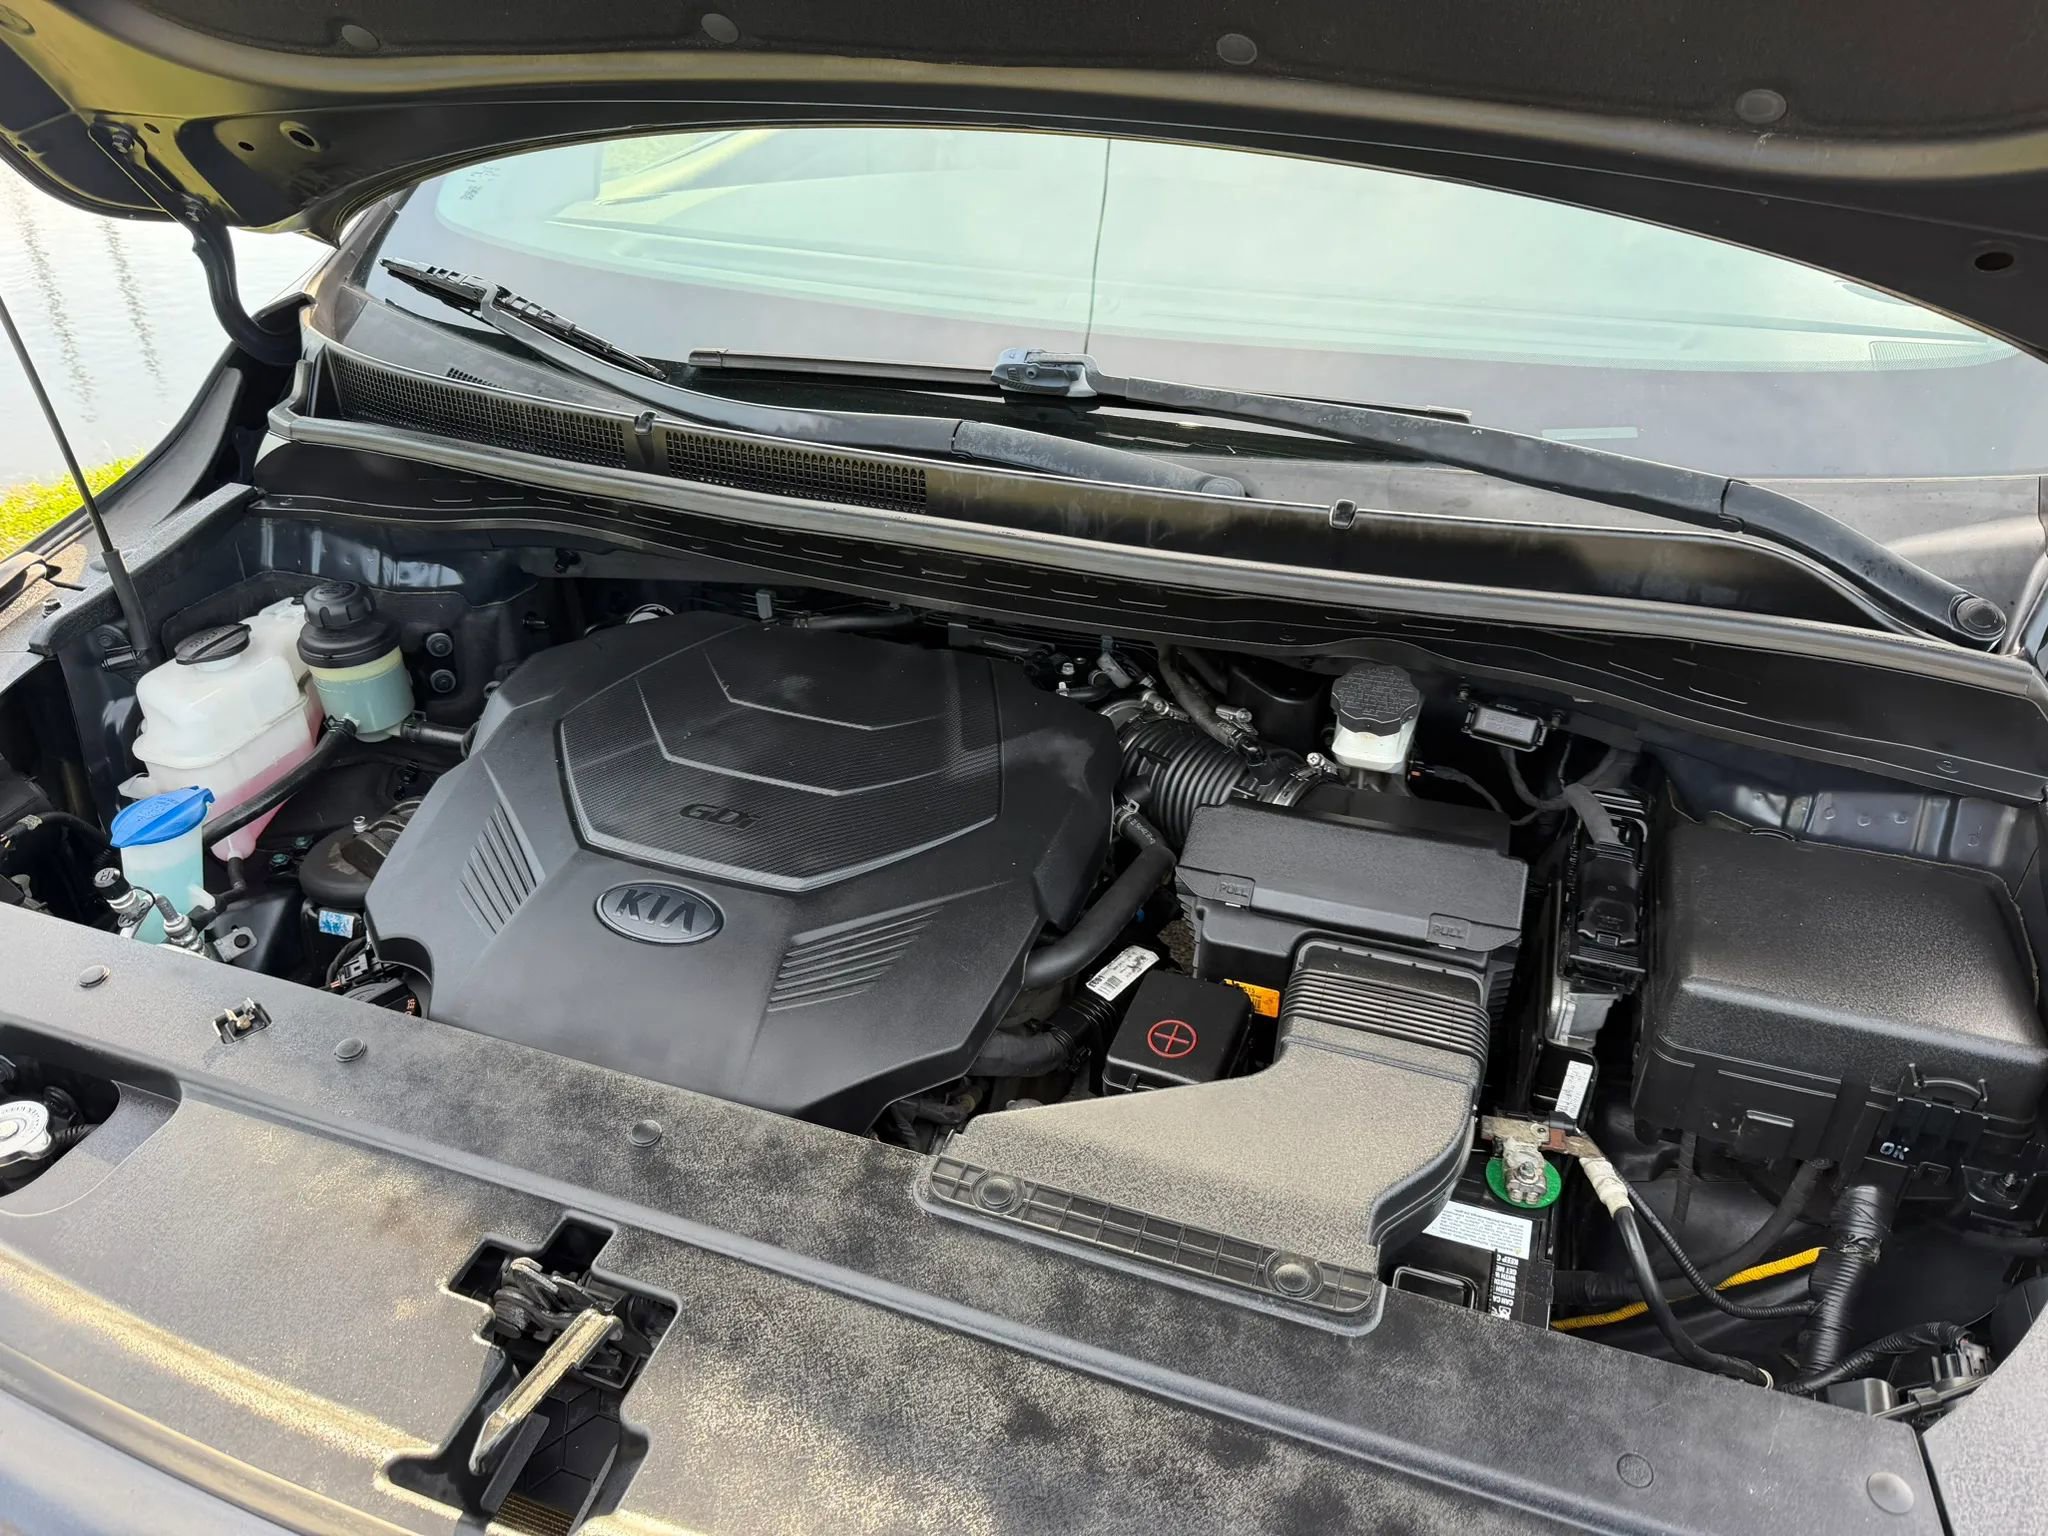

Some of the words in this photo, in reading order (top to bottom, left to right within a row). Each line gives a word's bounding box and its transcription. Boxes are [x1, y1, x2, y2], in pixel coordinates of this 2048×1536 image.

[1219, 881, 1249, 898] PULL
[613, 888, 697, 934] KIA
[1431, 923, 1465, 939] PULL
[1880, 1142, 1910, 1160] OK
